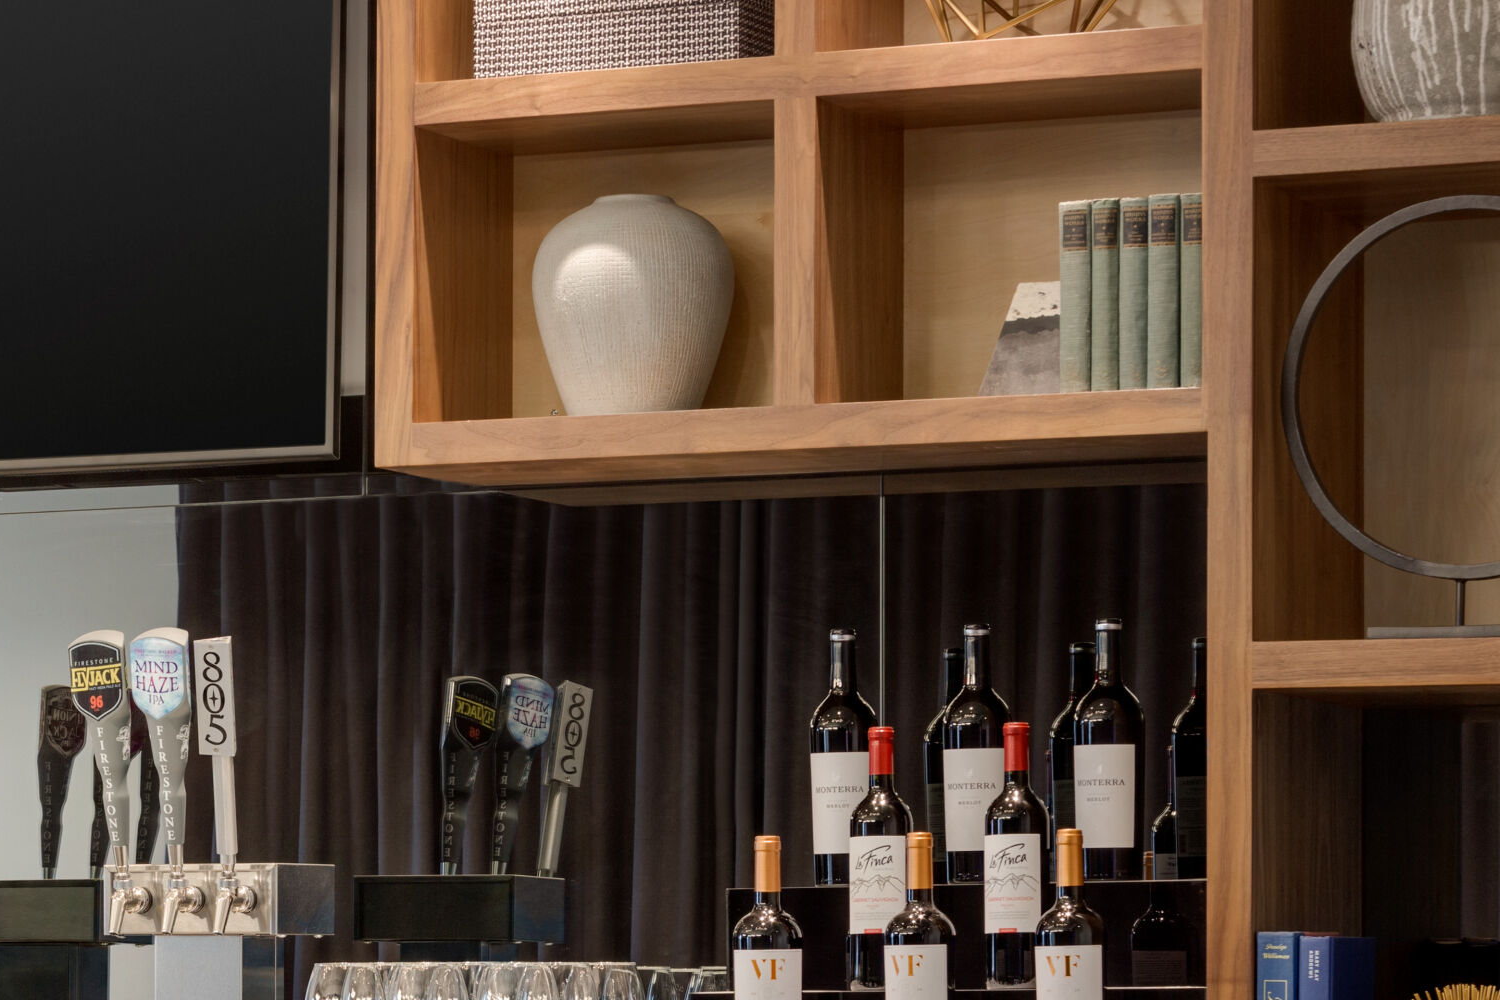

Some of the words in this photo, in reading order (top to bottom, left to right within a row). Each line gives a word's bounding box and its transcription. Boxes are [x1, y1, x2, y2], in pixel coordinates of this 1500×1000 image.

[74, 657, 114, 667] FIRESTONE
[135, 660, 178, 675] MIND
[136, 675, 179, 694] HAZE
[89, 695, 104, 709] 96
[149, 694, 165, 705] IPA
[202, 651, 227, 746] 805
[97, 727, 119, 842] FIRESTONE
[156, 725, 176, 841] FIRESTONE
[815, 785, 864, 794] MONTERRA
[947, 782, 997, 790] MONTERRA
[1077, 778, 1126, 786] MONTERRA
[861, 845, 894, 874] Finca
[995, 843, 1027, 872] Finca
[750, 959, 786, 980] VF
[891, 954, 924, 976] VF
[1046, 954, 1081, 977] VF
